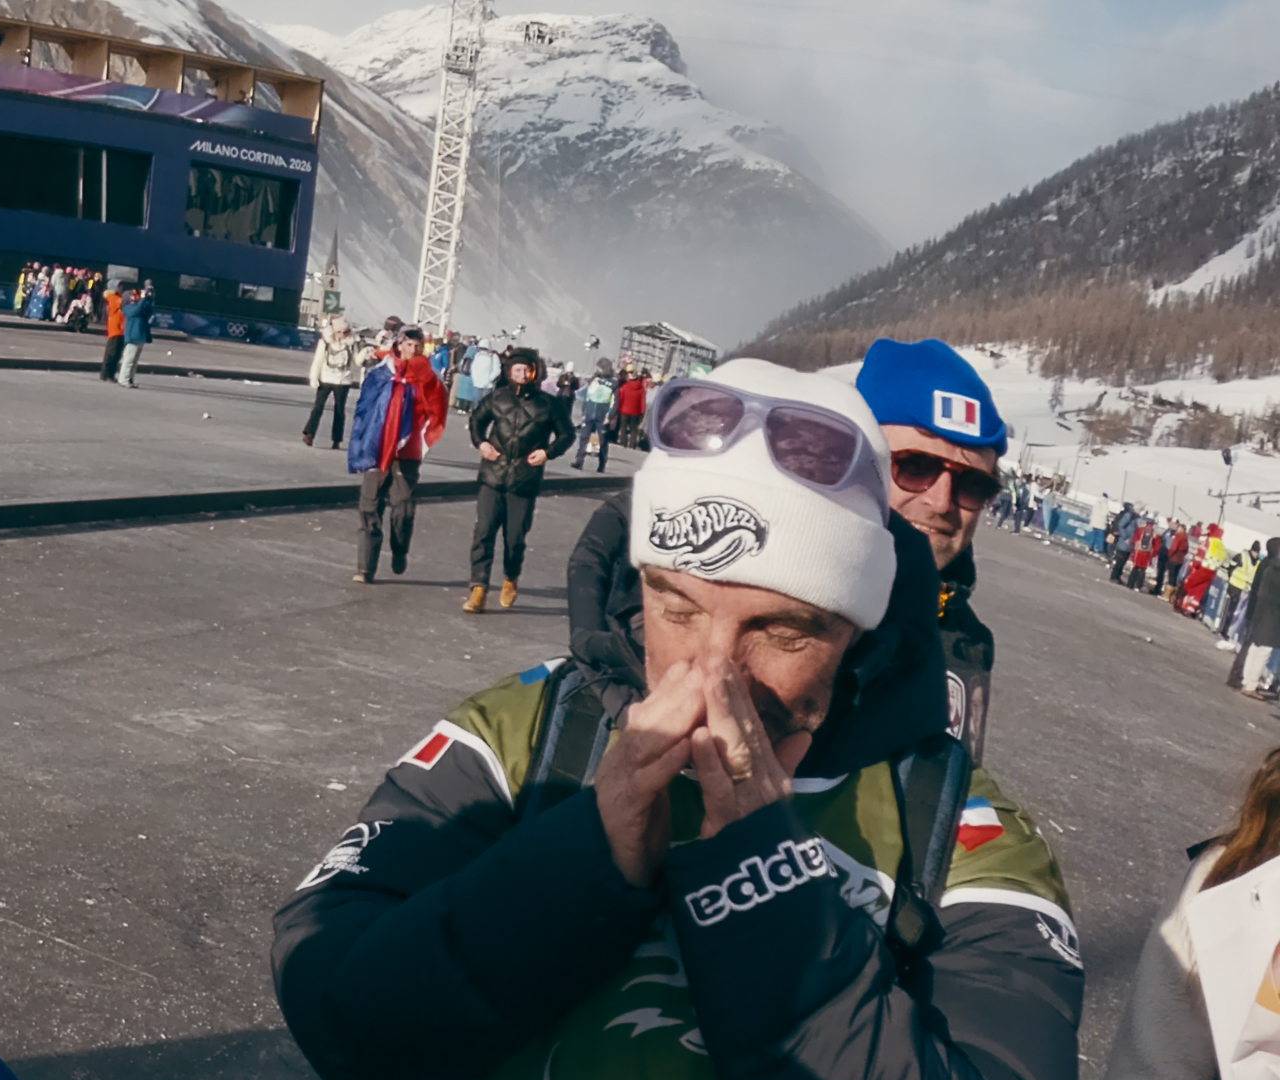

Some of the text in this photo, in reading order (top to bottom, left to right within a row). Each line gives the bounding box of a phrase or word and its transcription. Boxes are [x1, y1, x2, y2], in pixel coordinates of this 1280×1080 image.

[189, 140, 313, 173] MILANO CORTINA 2026
